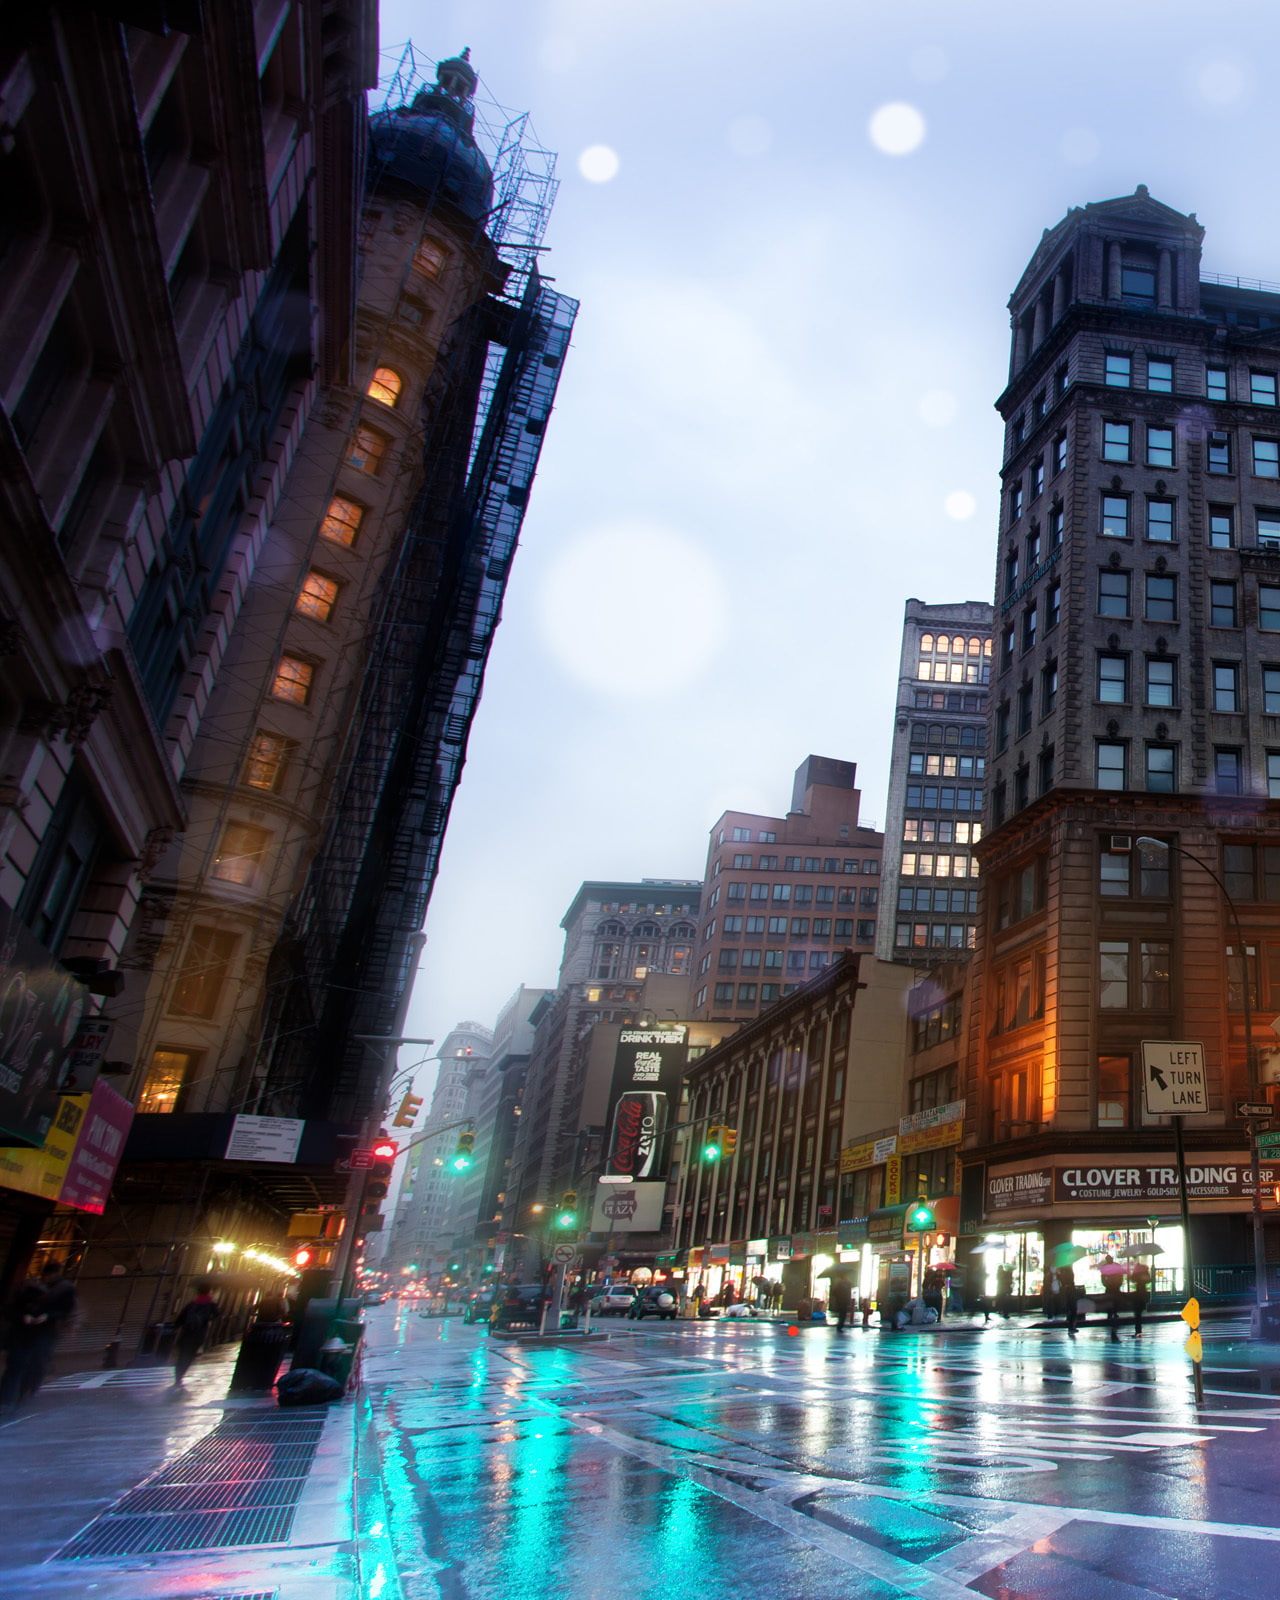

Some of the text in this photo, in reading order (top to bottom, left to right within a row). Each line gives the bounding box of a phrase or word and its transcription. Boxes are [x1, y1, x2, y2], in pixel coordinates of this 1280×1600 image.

[620, 1034, 684, 1044] DRINK THEM
[635, 1051, 662, 1060] REAL
[1169, 1051, 1198, 1065] LEFT
[634, 1065, 660, 1073] TASTE
[1170, 1071, 1202, 1085] TURN
[1172, 1091, 1202, 1105] LANE
[612, 1099, 643, 1172] Coca-Cola
[637, 1116, 655, 1156] zero
[1261, 1150, 1268, 1158] W
[1271, 1150, 1280, 1158] 28
[889, 1159, 899, 1195] SOCKS
[990, 1176, 1014, 1195] CLOVER
[1015, 1171, 1044, 1191] TRADING
[1062, 1168, 1141, 1187] CLOVER
[1079, 1188, 1112, 1198] COSTUME
[1112, 1188, 1142, 1199] JEWELRY
[603, 1206, 635, 1215] PLAZA
